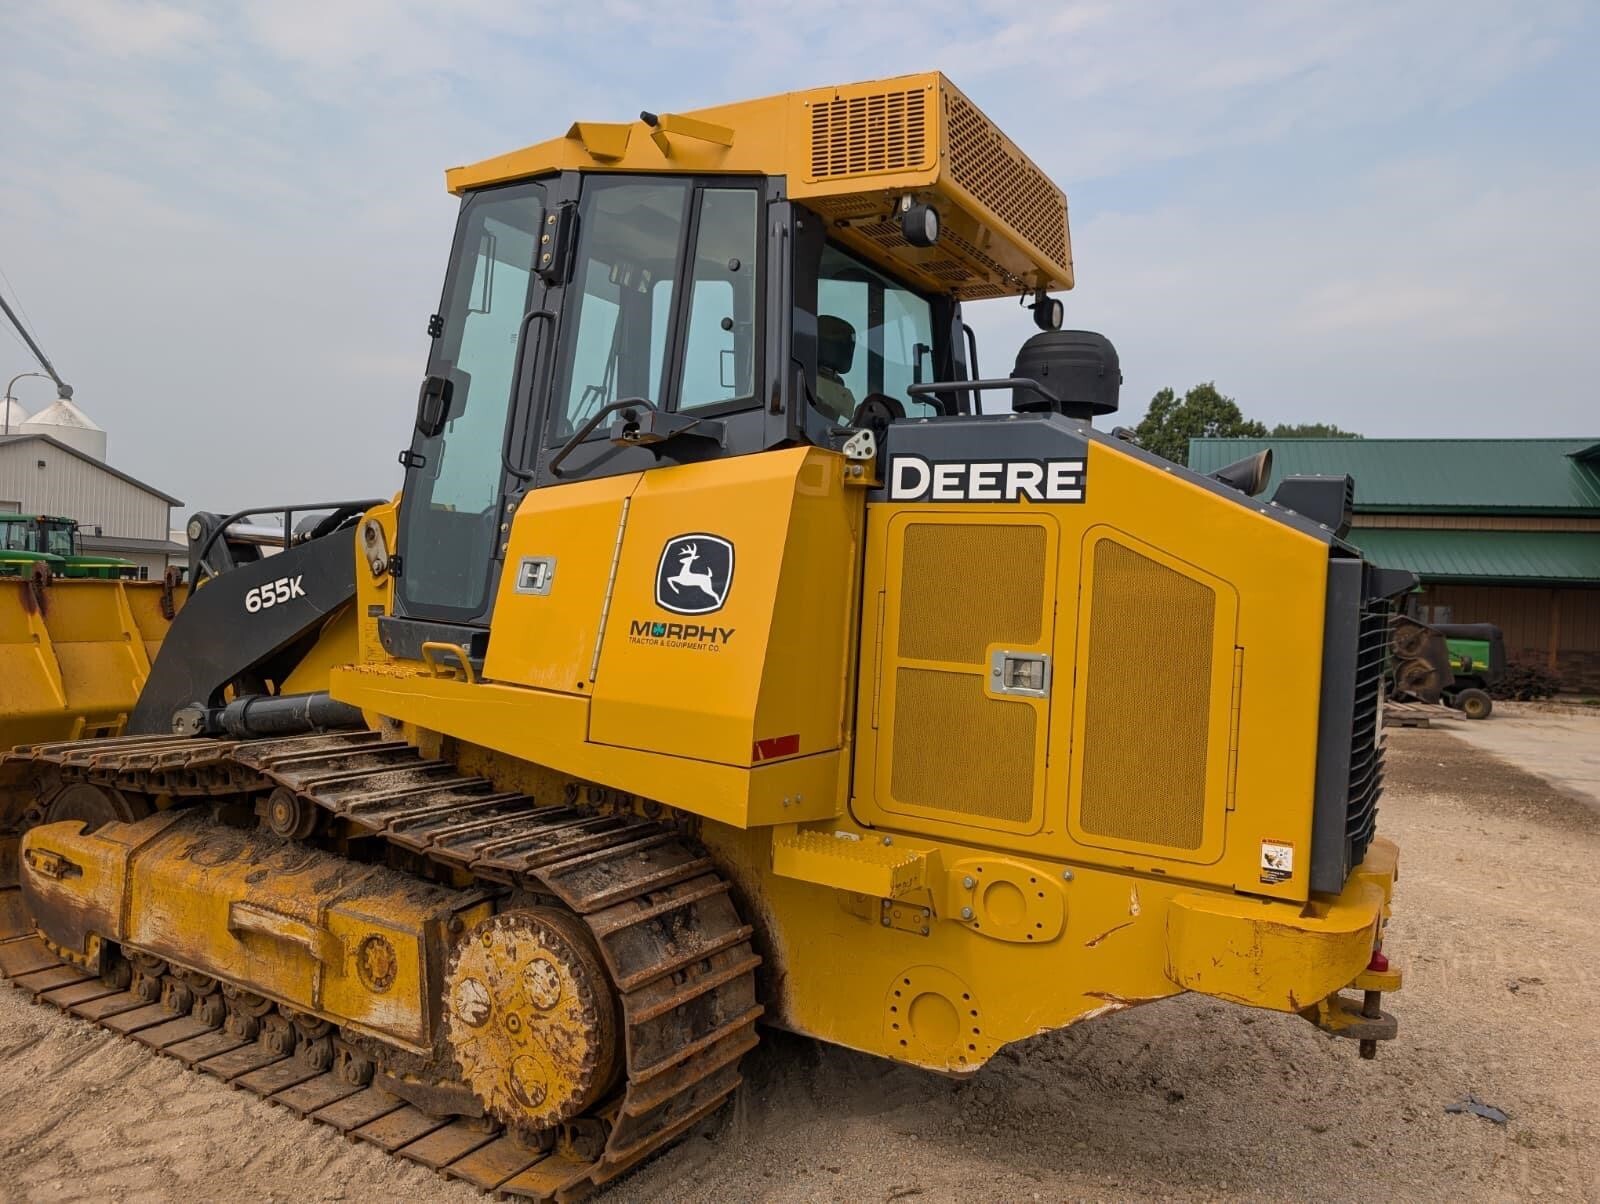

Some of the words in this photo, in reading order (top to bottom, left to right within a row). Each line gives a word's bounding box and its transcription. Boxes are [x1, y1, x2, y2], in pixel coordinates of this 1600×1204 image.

[891, 457, 1083, 500] DEERE
[245, 575, 306, 613] 655K
[629, 636, 659, 646] TRACTOR
[666, 640, 707, 650] EQUIPMENT
[630, 620, 736, 644] MURPHY
